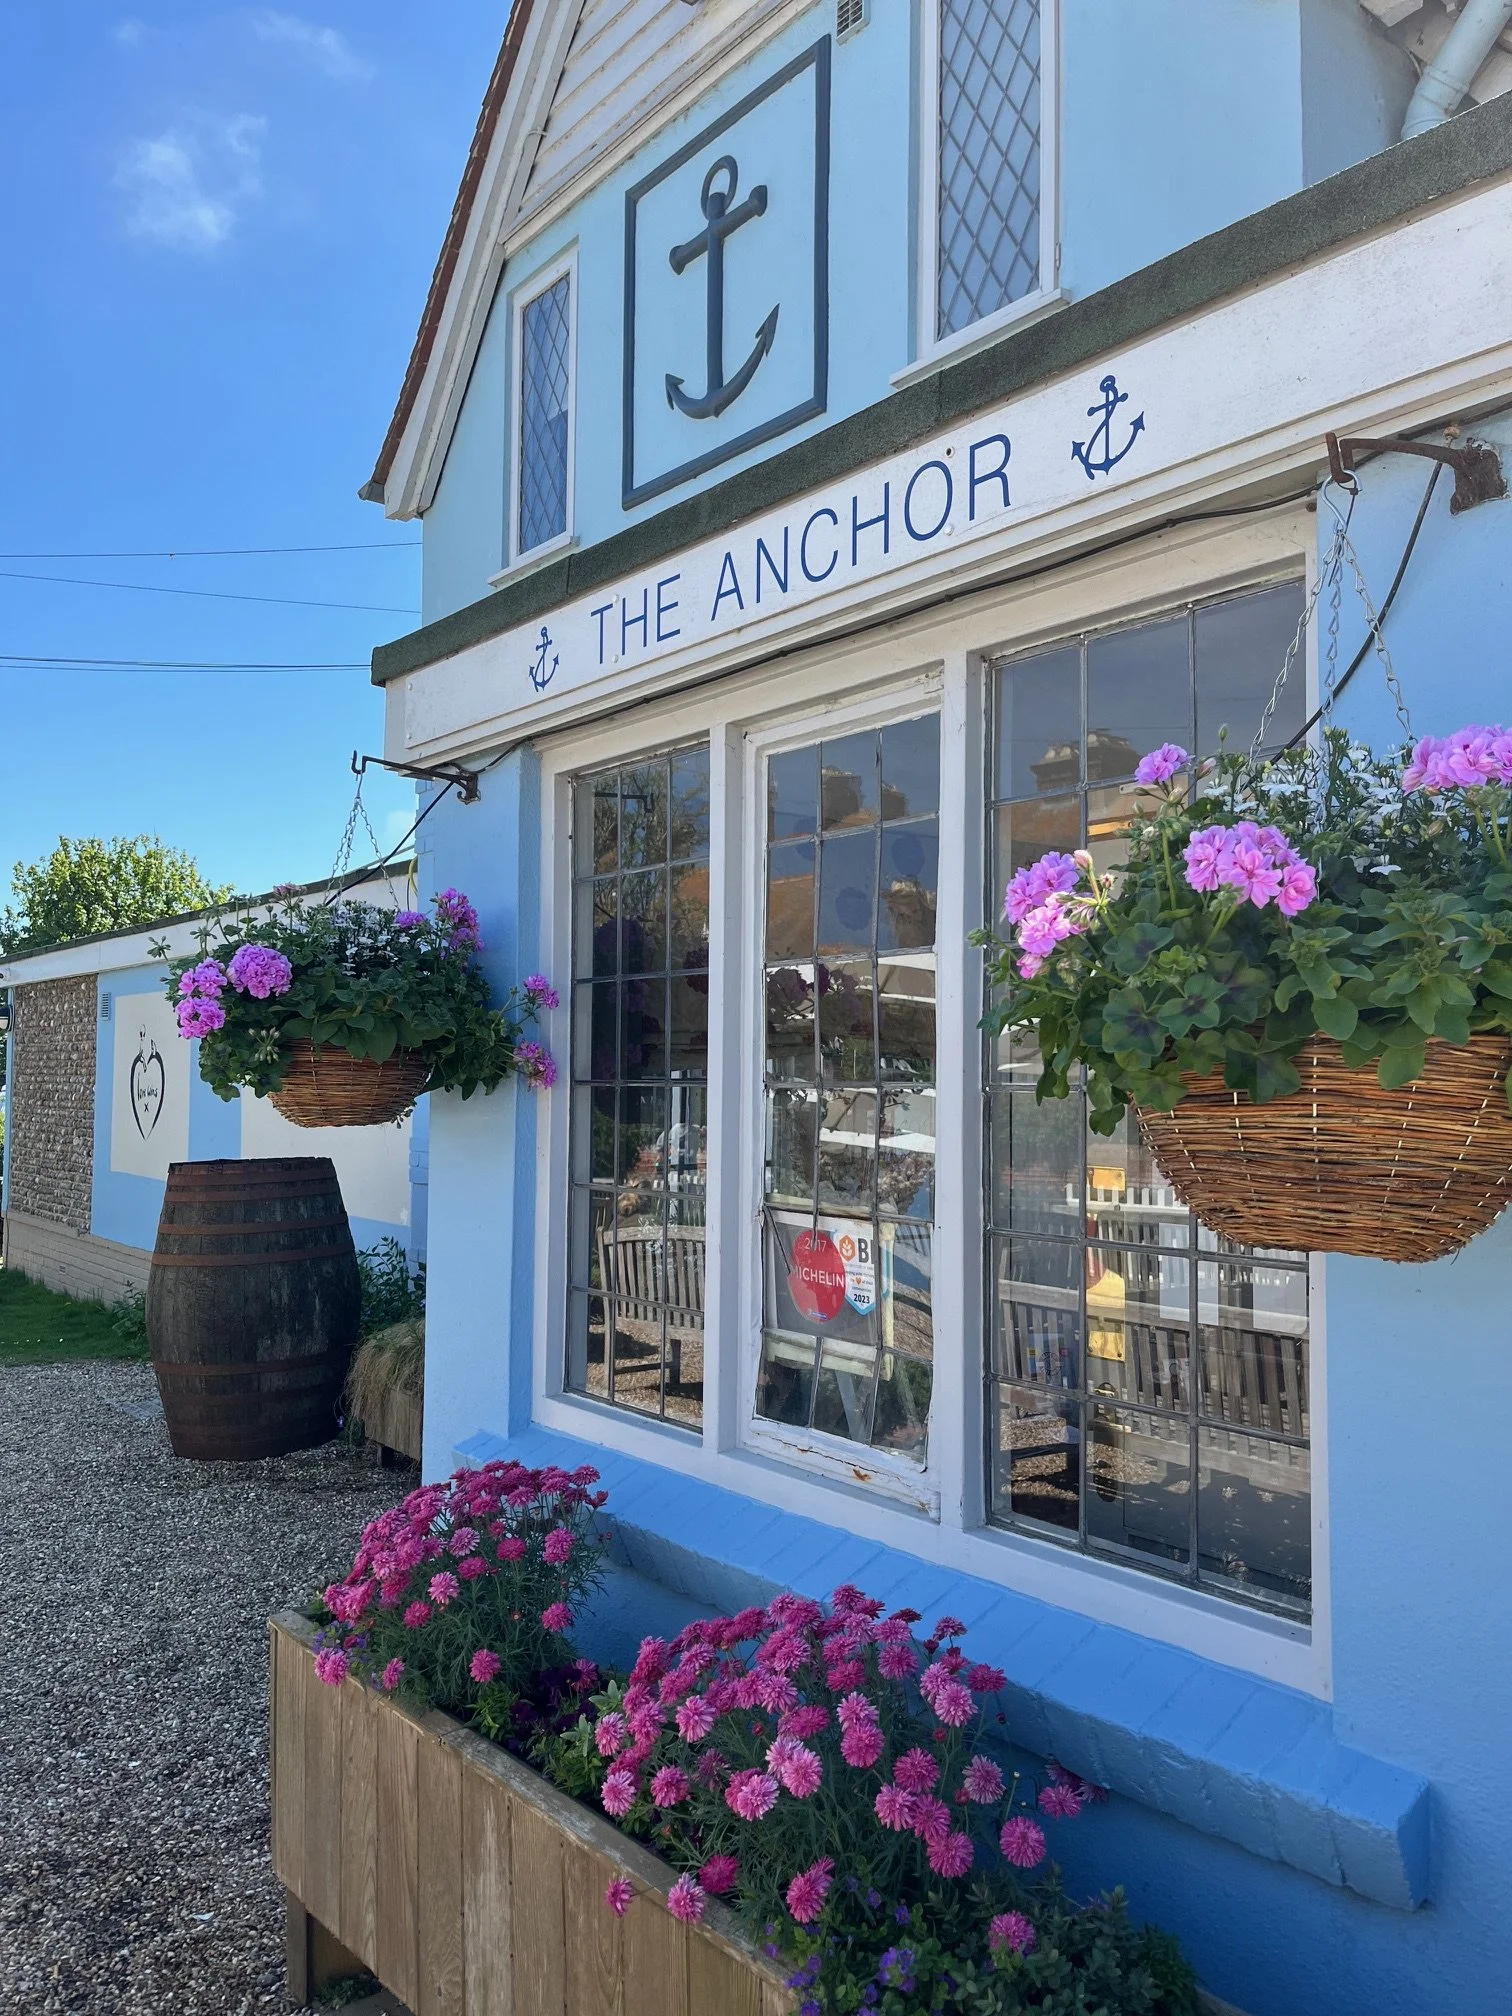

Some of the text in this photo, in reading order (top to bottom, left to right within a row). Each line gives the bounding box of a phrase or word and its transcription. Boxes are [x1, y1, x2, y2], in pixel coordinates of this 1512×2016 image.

[590, 433, 1012, 665] THE ANCHOR
[790, 1265, 845, 1288] MICHELIN
[853, 1293, 870, 1304] 2023
